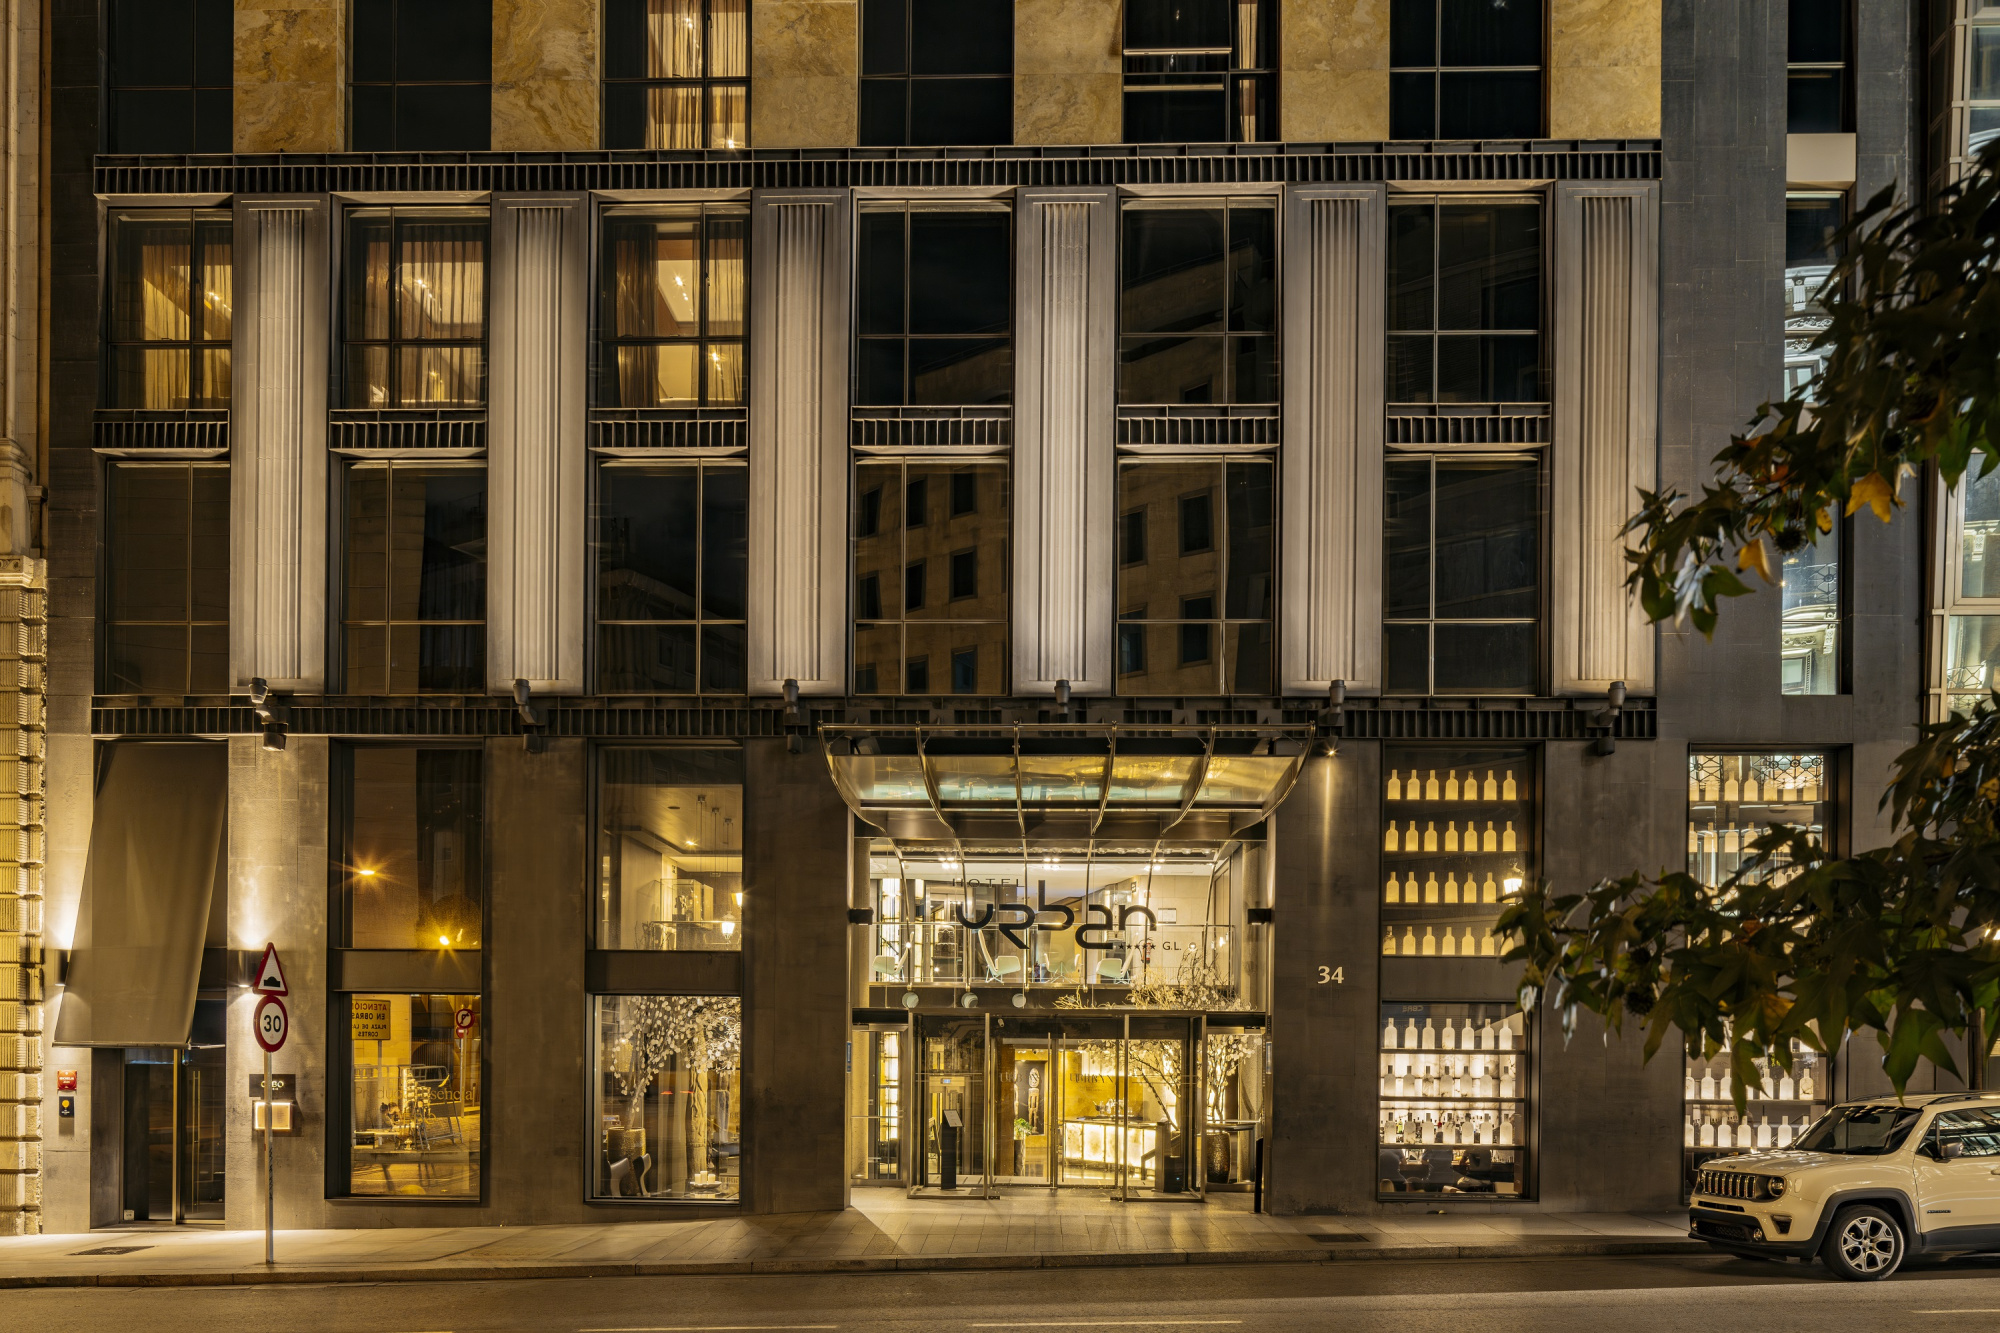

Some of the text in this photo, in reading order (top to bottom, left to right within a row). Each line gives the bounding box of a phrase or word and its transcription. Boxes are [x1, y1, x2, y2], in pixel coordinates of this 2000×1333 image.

[952, 878, 1025, 888] HOTEL
[1317, 965, 1345, 984] 34
[263, 1014, 282, 1033] 30
[260, 1080, 285, 1089] CBO
